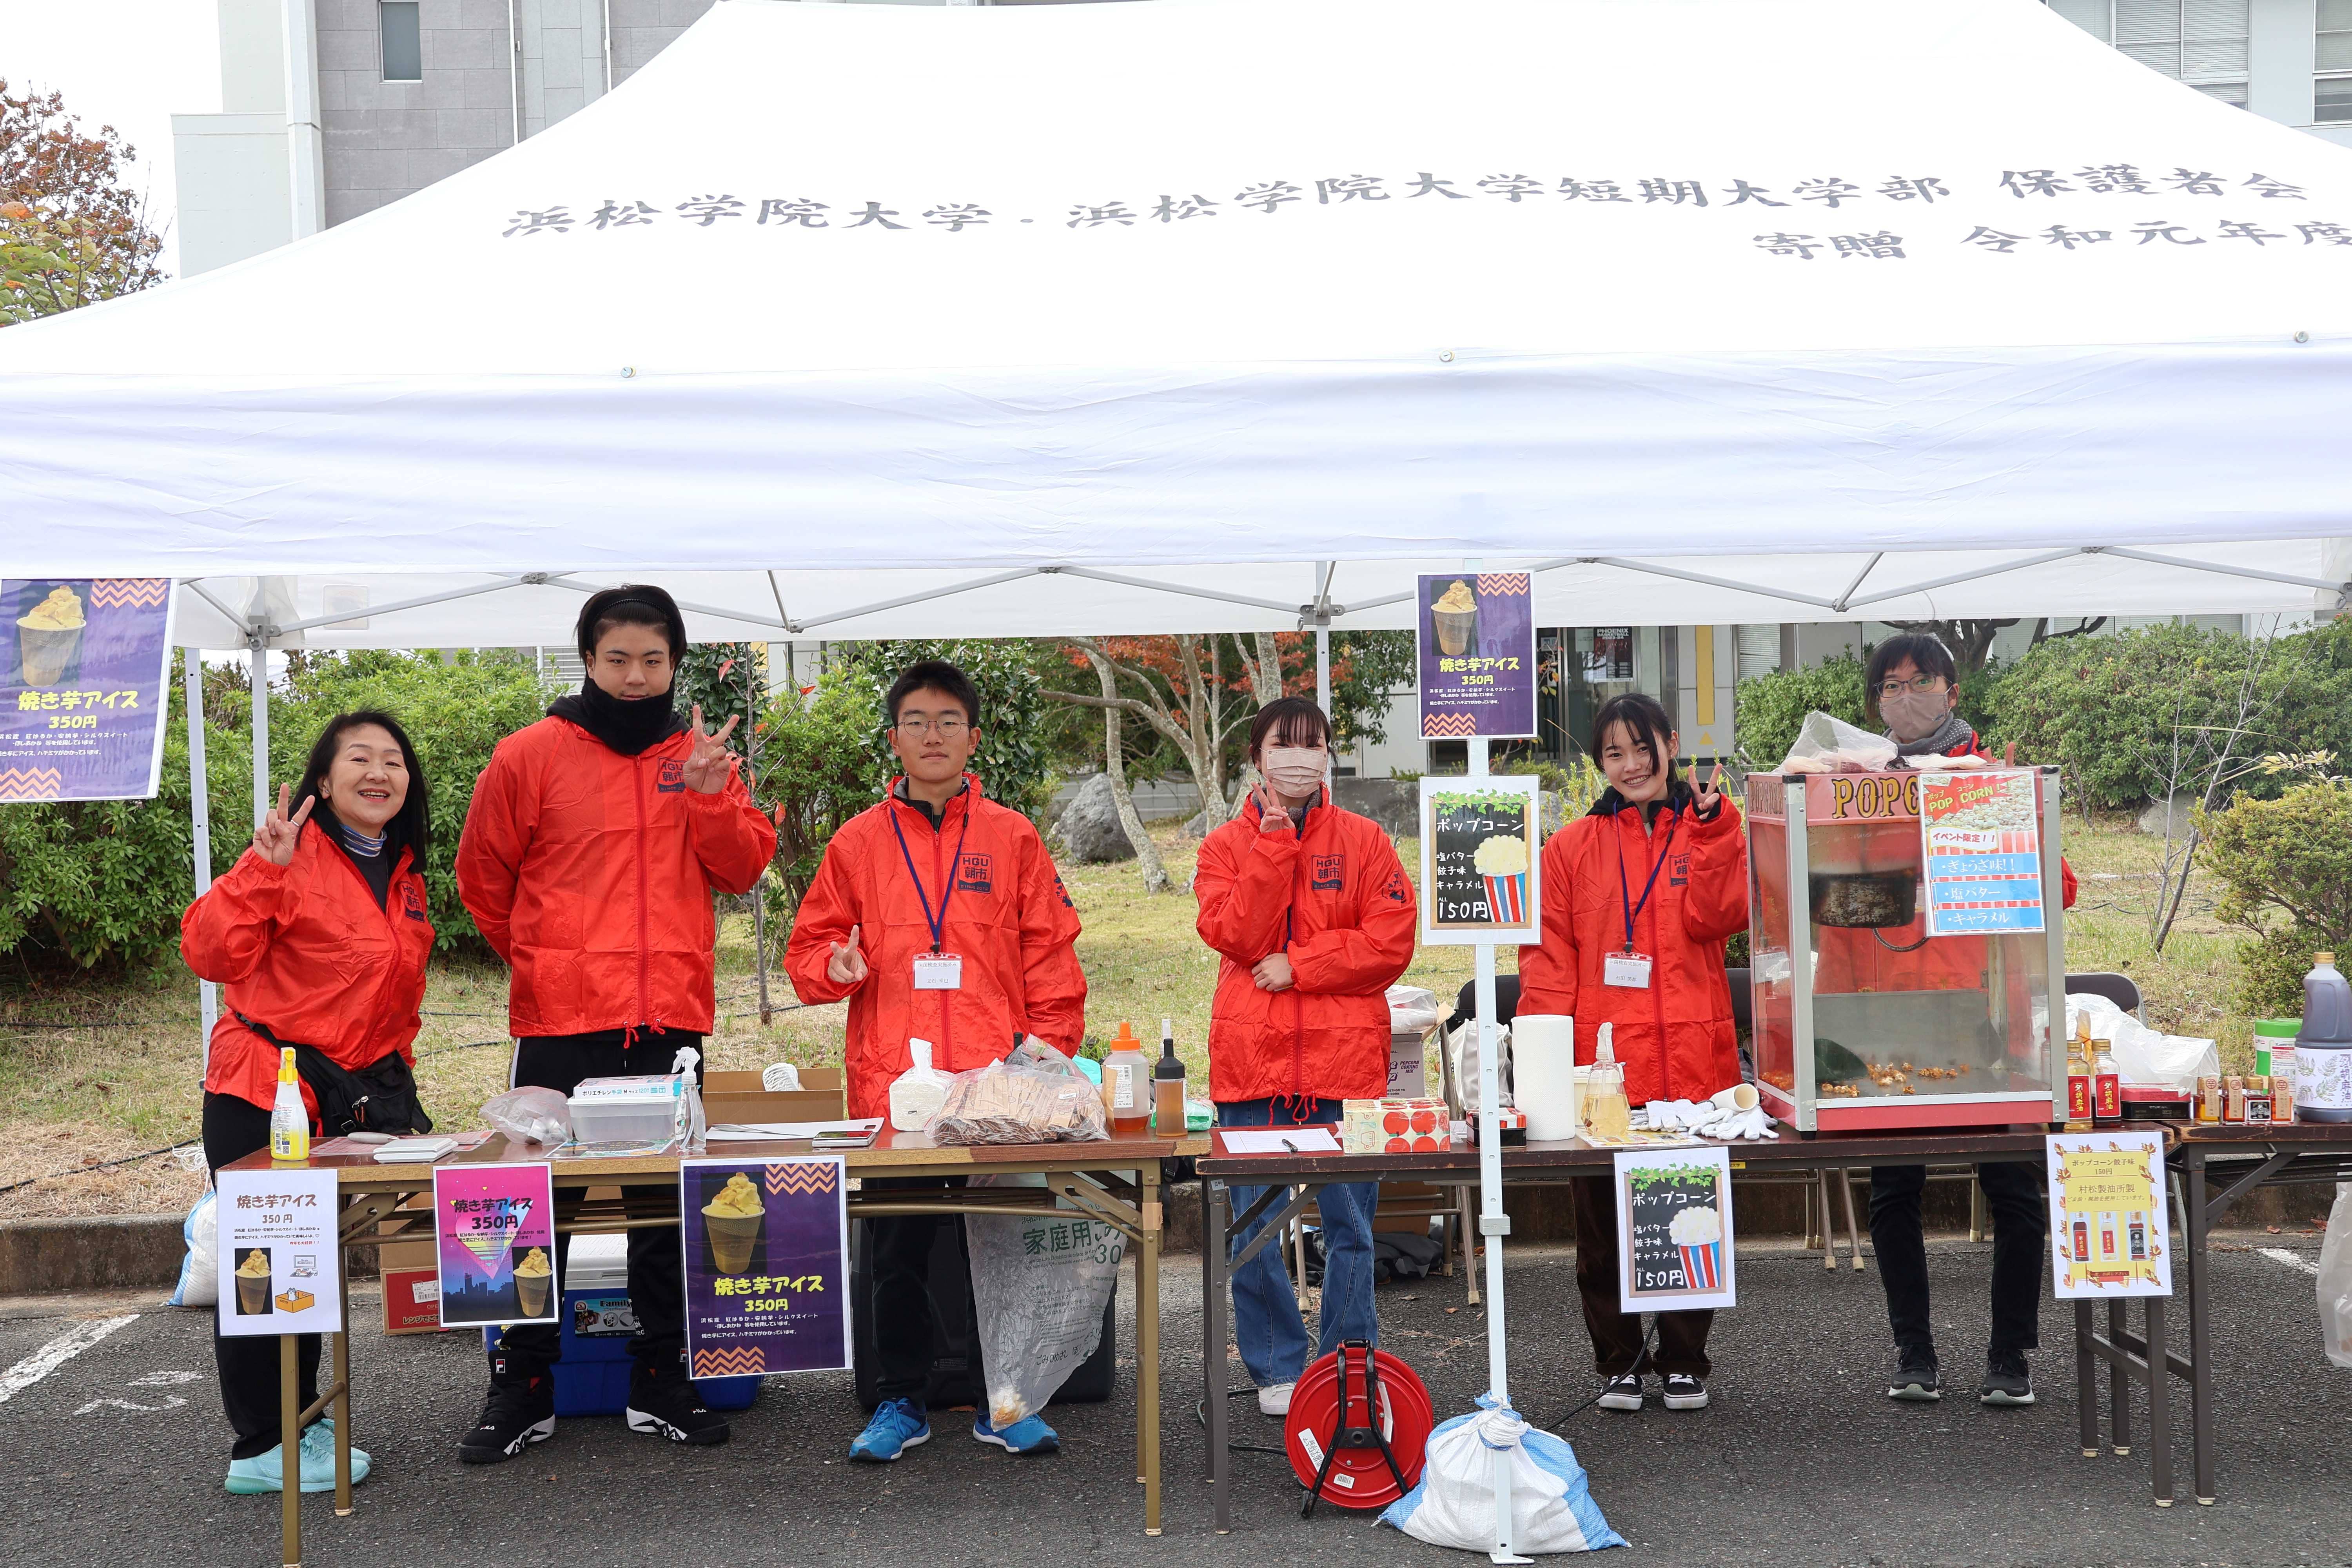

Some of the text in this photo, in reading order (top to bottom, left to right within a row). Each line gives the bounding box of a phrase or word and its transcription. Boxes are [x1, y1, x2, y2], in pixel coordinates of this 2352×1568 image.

[1999, 163, 2307, 200] 保護者会
[1753, 220, 2352, 260] 寄贈 令和元年度
[1439, 657, 1520, 672] 焼き芋アイス
[1461, 675, 1494, 685] 350円
[17, 690, 140, 711] 焼き芋アイス
[48, 715, 97, 729] 350円
[1927, 783, 1974, 800] ポップ コーン
[1929, 797, 1953, 812] POP
[1436, 818, 1524, 833] ポップコーン
[962, 857, 989, 867] HGU
[1316, 858, 1340, 868] HGU
[1436, 851, 1475, 862] 塩バター
[964, 867, 987, 880] 朝市
[1318, 867, 1340, 879] 朝市
[1437, 866, 1467, 876] 餃子味
[1436, 880, 1484, 891] キャラメル
[1438, 901, 1489, 919] 150円
[2079, 1183, 2135, 1194] 村松製油所製
[236, 1194, 318, 1209] 焼き芋アイス
[454, 1197, 534, 1213] 焼き芋アイス
[1632, 1191, 1716, 1207] ポップコーン
[262, 1214, 281, 1224] 350
[471, 1215, 518, 1230] 350円
[1633, 1223, 1670, 1234] 塩バター
[1635, 1238, 1663, 1248] 餃子味
[1094, 1244, 1122, 1265] 30
[1634, 1251, 1679, 1261] キャラメル
[1636, 1269, 1684, 1287] 150円
[714, 1275, 825, 1296] 焼き芋アイス
[744, 1298, 789, 1312] 350円
